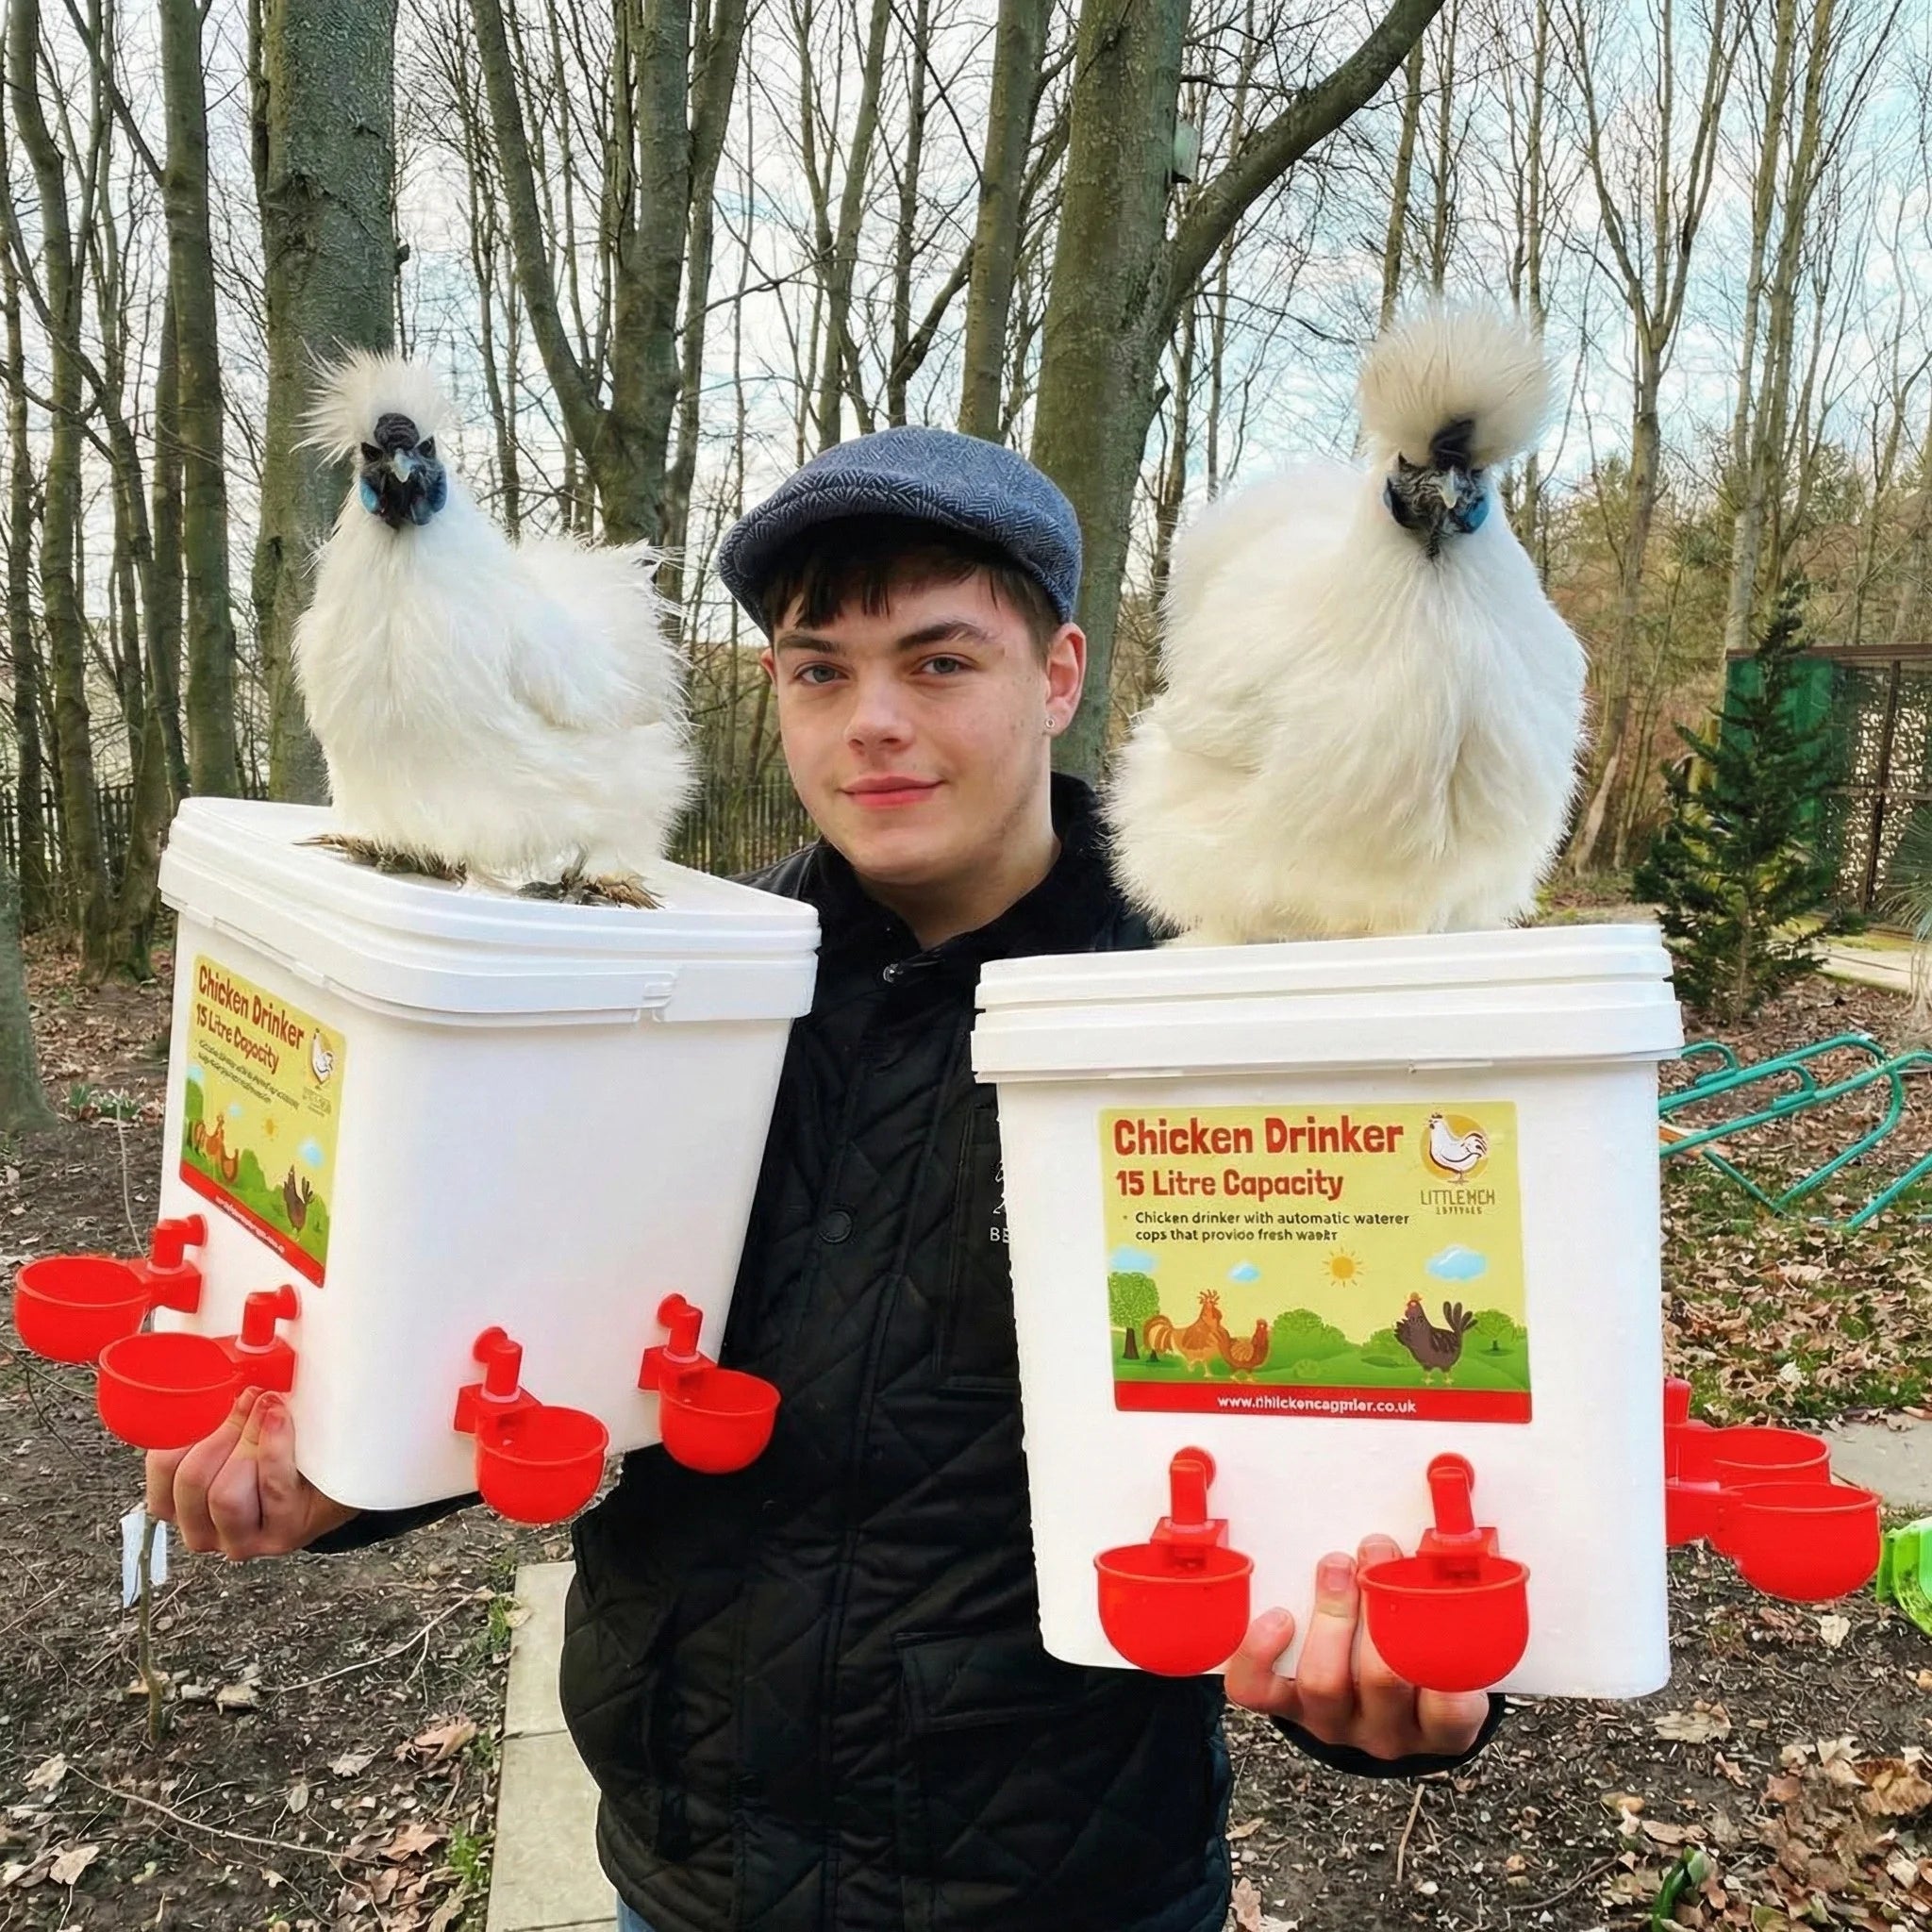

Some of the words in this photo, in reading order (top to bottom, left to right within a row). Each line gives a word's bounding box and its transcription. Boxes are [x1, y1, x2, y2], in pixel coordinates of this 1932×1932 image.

[199, 964, 249, 1019] Chicken
[252, 994, 305, 1050] Drinker
[196, 1003, 208, 1027] 15
[208, 1011, 232, 1043] Litre
[233, 1026, 279, 1074] Capacity
[1113, 1117, 1254, 1157] Chicken
[1264, 1115, 1404, 1155] Drinker
[1116, 1171, 1144, 1197] 15
[1154, 1168, 1216, 1196] Litre
[1224, 1169, 1343, 1202] Capacity
[1135, 1211, 1189, 1224] Chicken
[1192, 1211, 1240, 1224] drinker
[1243, 1211, 1274, 1224] with
[1277, 1211, 1350, 1224] automatic
[1354, 1213, 1409, 1225] waterer
[1171, 1228, 1198, 1241] that
[1258, 1228, 1292, 1241] fresh
